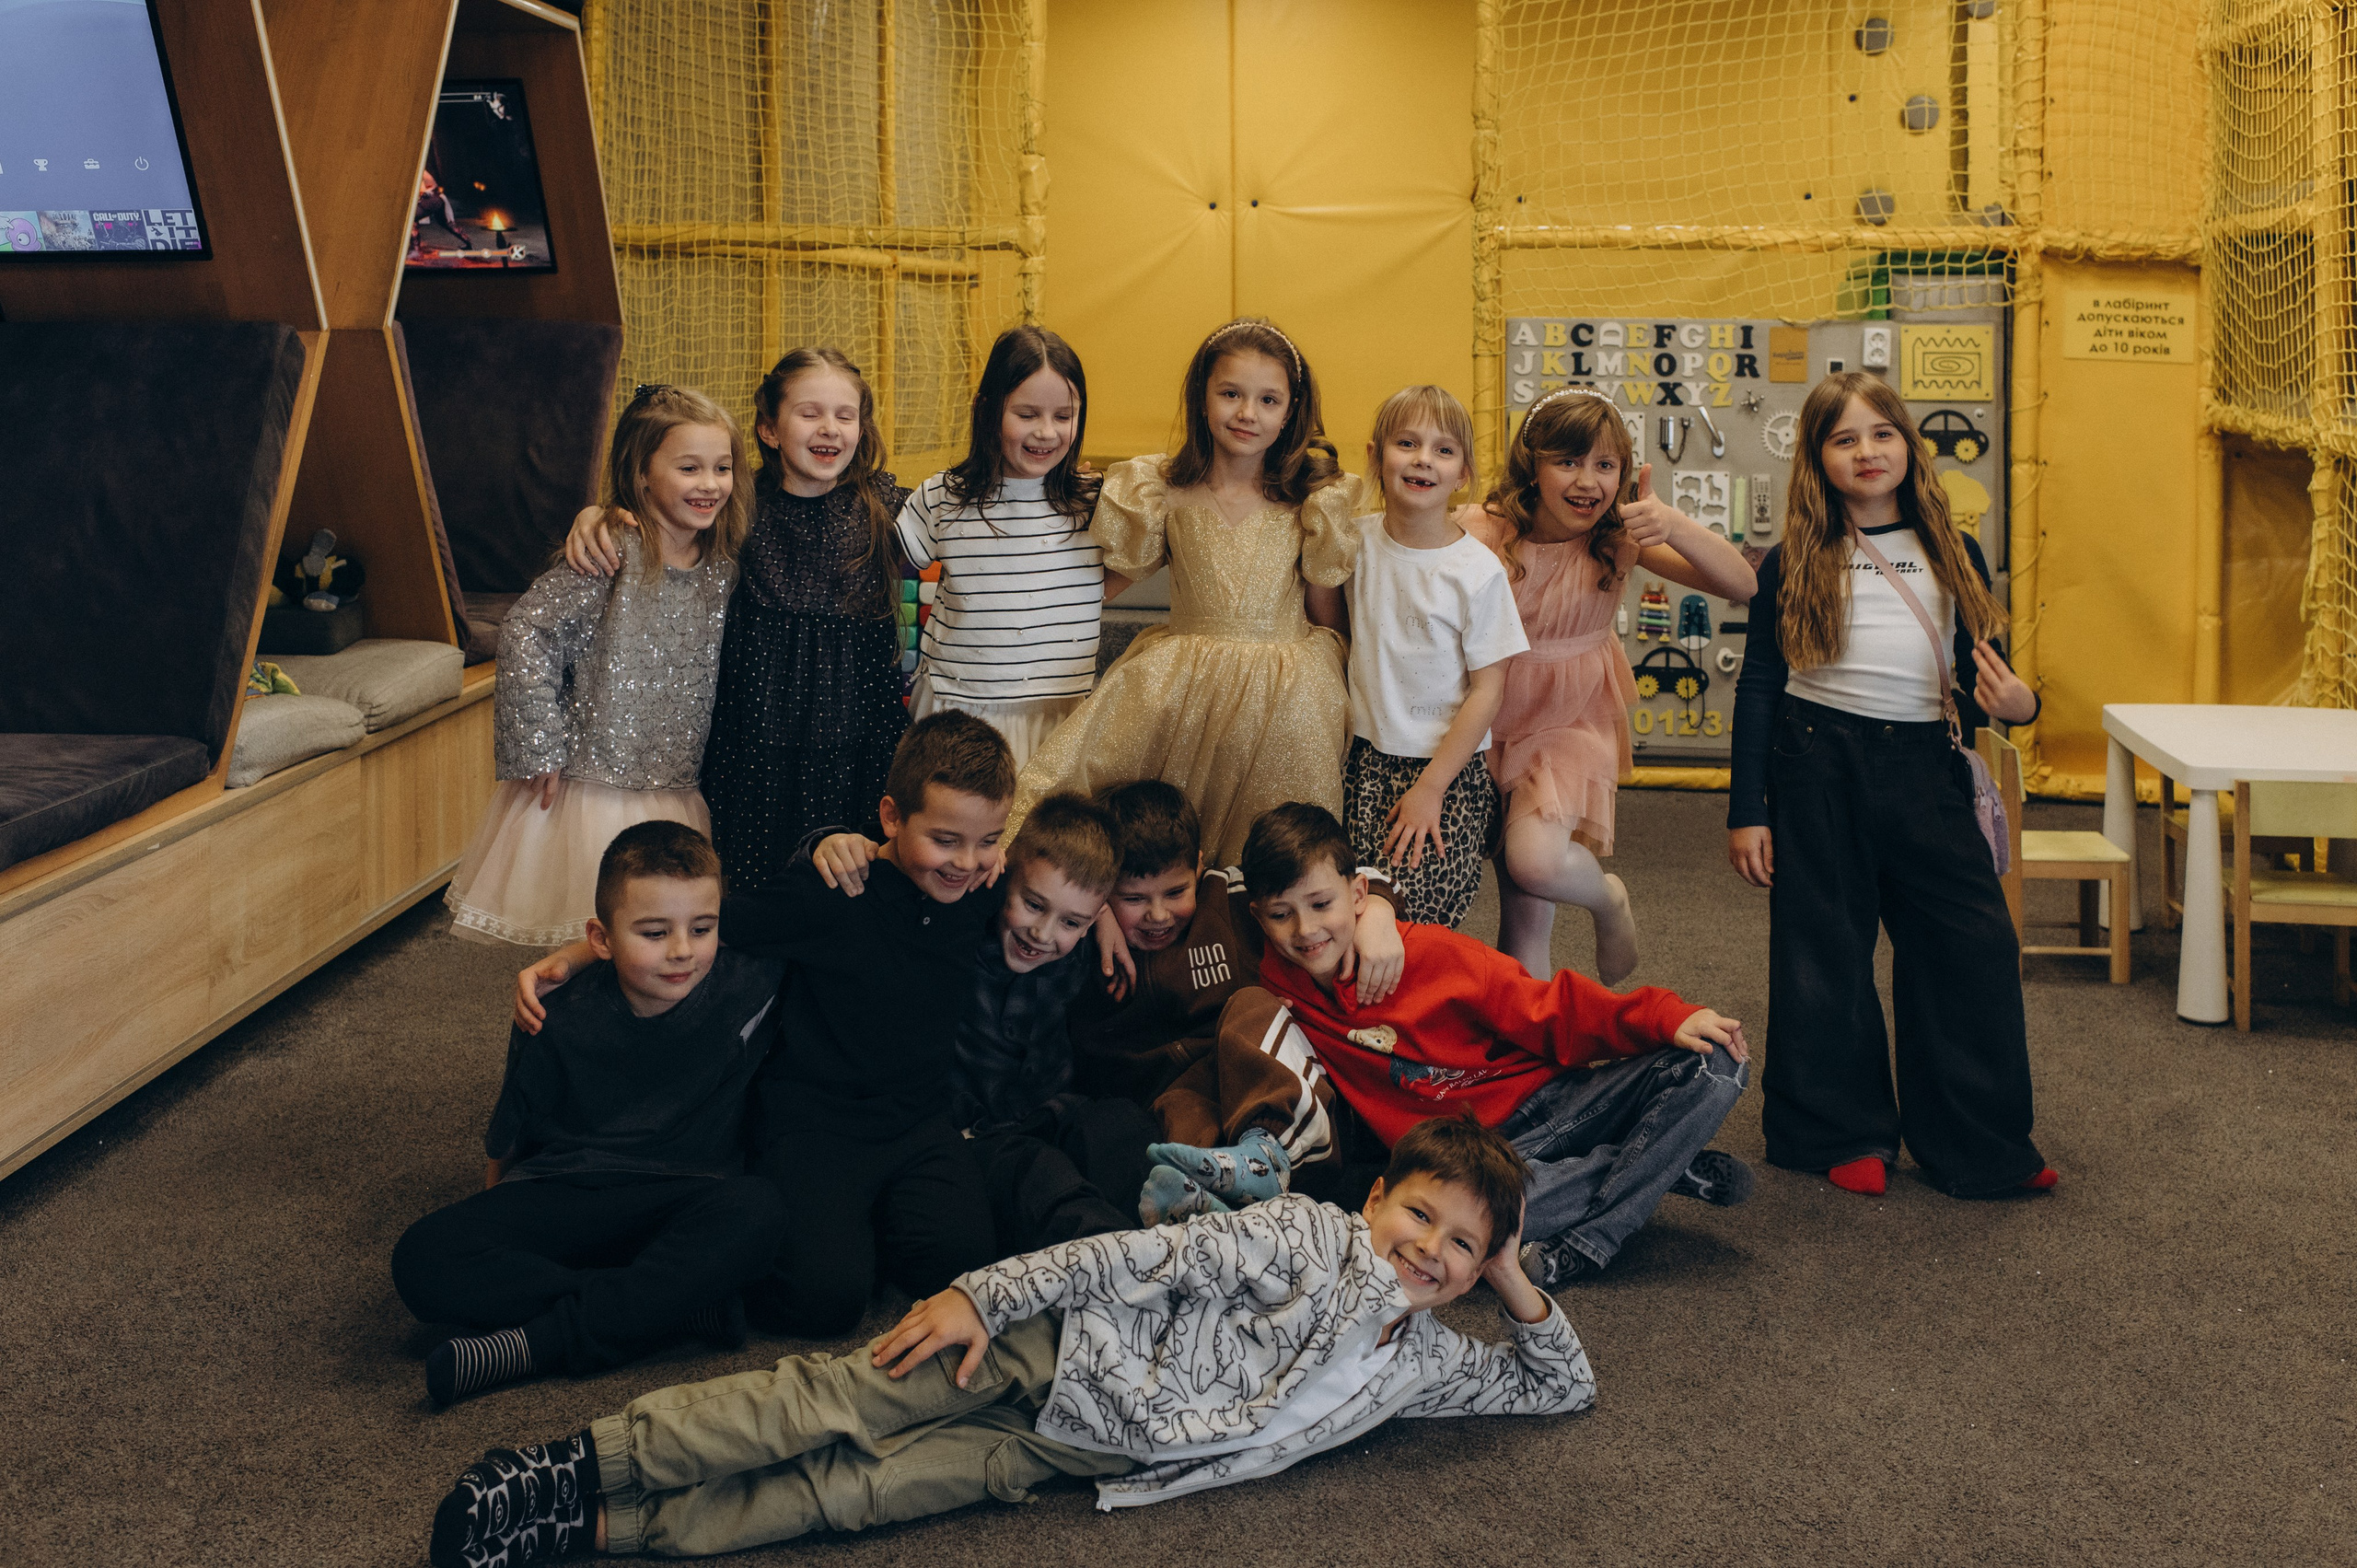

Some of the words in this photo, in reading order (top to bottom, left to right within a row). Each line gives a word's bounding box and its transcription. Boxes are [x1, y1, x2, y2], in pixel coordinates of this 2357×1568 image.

[93, 213, 113, 222] CALL
[118, 212, 140, 221] DUTY
[145, 210, 192, 226] LET
[168, 226, 196, 238] IT
[2105, 297, 2170, 311] лабіринт
[2077, 312, 2185, 326] допускаються
[2094, 326, 2123, 337] діти
[2128, 329, 2167, 340] віком
[2089, 344, 2107, 353] до
[2114, 343, 2129, 353] 10
[2133, 344, 2170, 355] років
